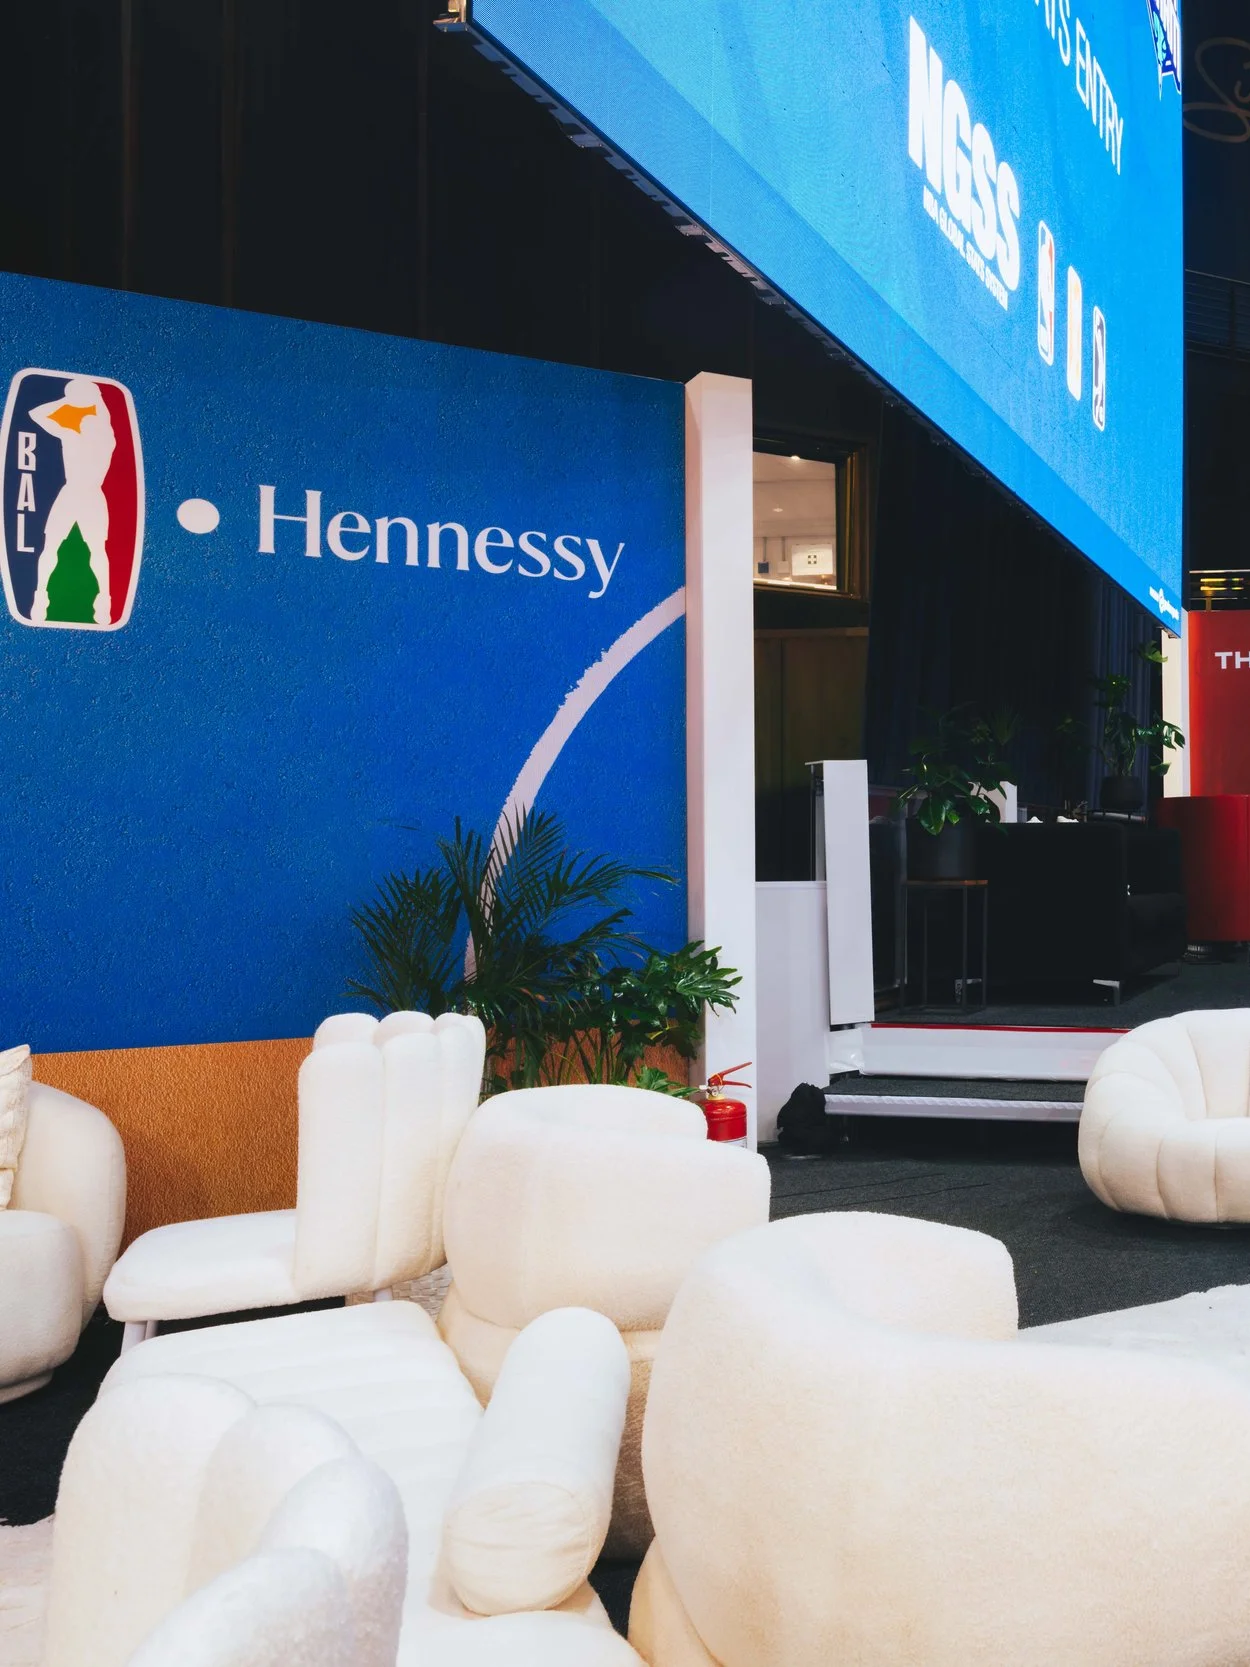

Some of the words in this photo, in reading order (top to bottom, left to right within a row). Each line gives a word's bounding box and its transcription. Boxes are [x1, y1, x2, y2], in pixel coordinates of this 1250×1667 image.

[907, 14, 1020, 291] NGSS
[1075, 16, 1124, 176] ENTRY
[16, 431, 37, 553] BAL
[258, 484, 625, 599] Hennessy
